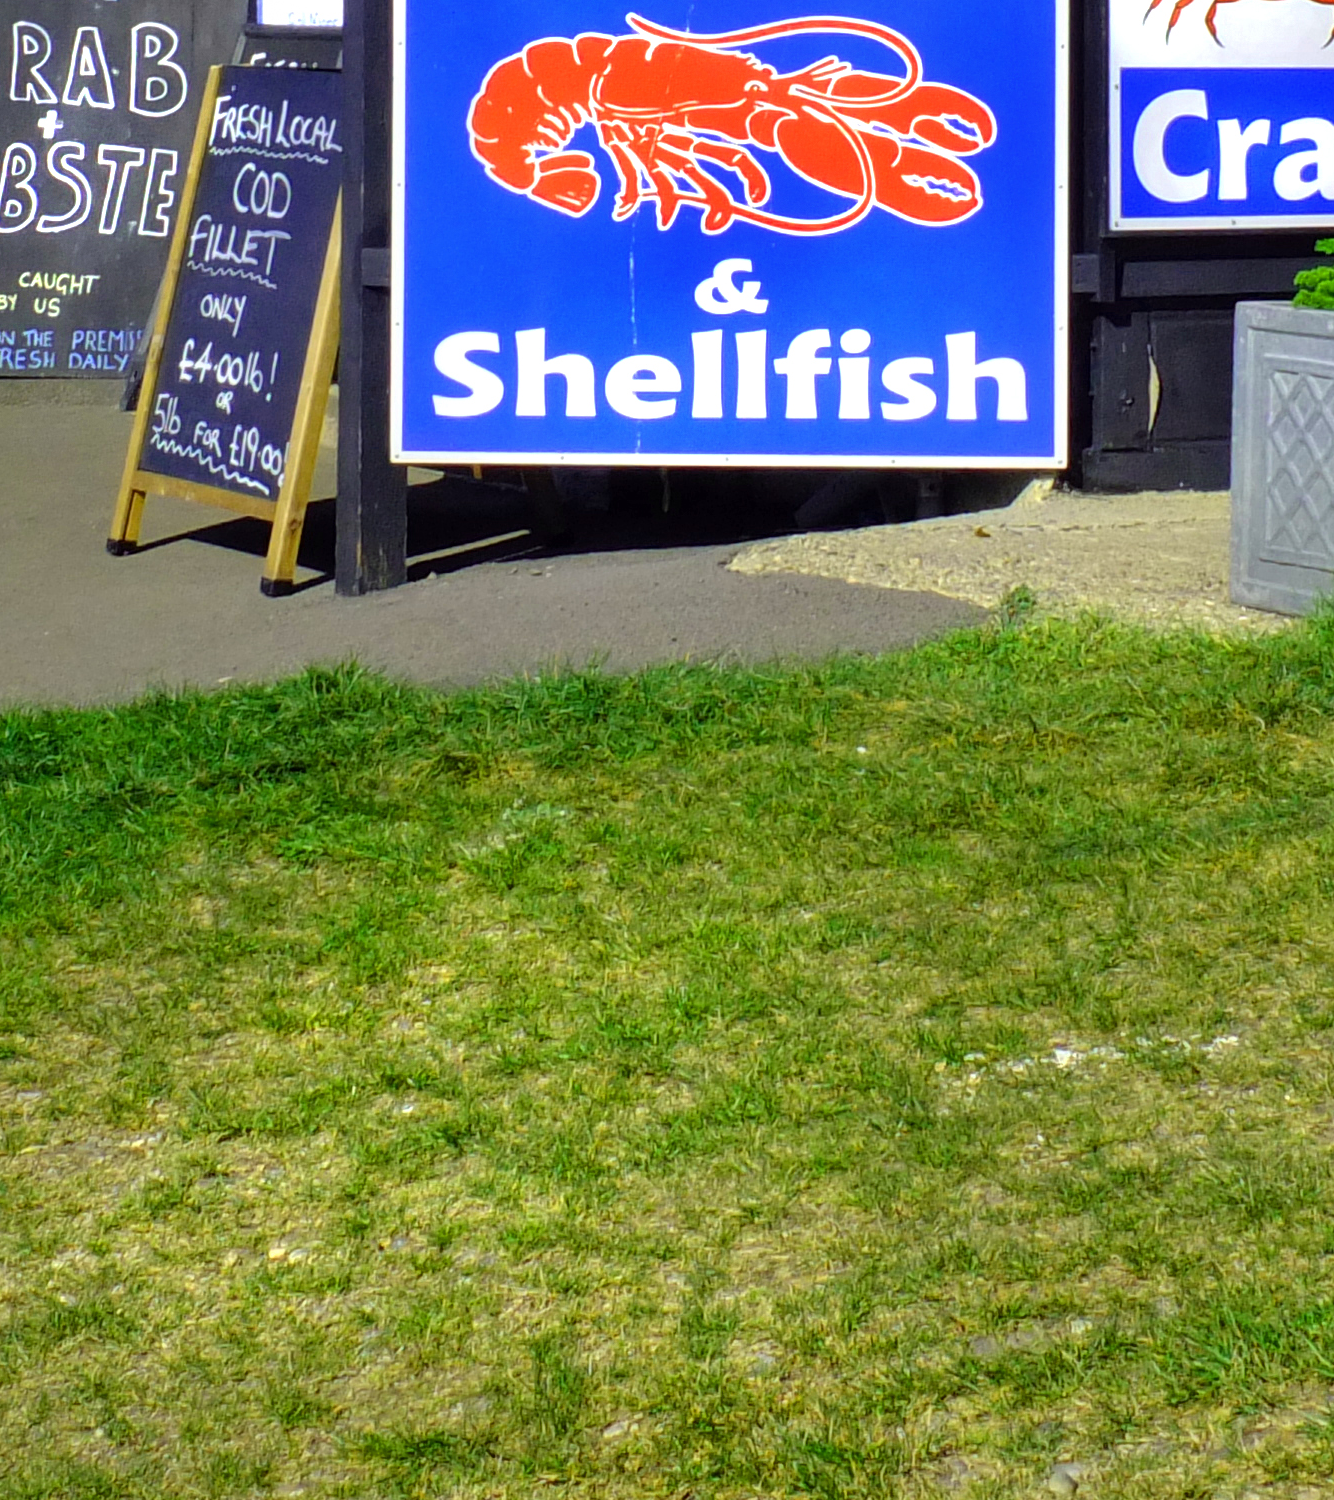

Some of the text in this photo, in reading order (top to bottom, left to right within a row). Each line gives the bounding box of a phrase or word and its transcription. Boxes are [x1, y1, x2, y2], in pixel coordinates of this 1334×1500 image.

[208, 95, 343, 152] FRESH LOCAL
[232, 162, 292, 219] COD
[187, 213, 292, 276] FILLET
[18, 271, 101, 296] CAUGHT
[34, 297, 61, 318] US
[693, 258, 769, 315] &
[22, 328, 55, 348] THE
[200, 293, 248, 338] ONLY
[68, 352, 129, 373] DAILY
[432, 327, 1028, 422] Shellfish
[152, 393, 182, 435] 5lb
[193, 421, 223, 458] FOR
[215, 391, 234, 416] OR
